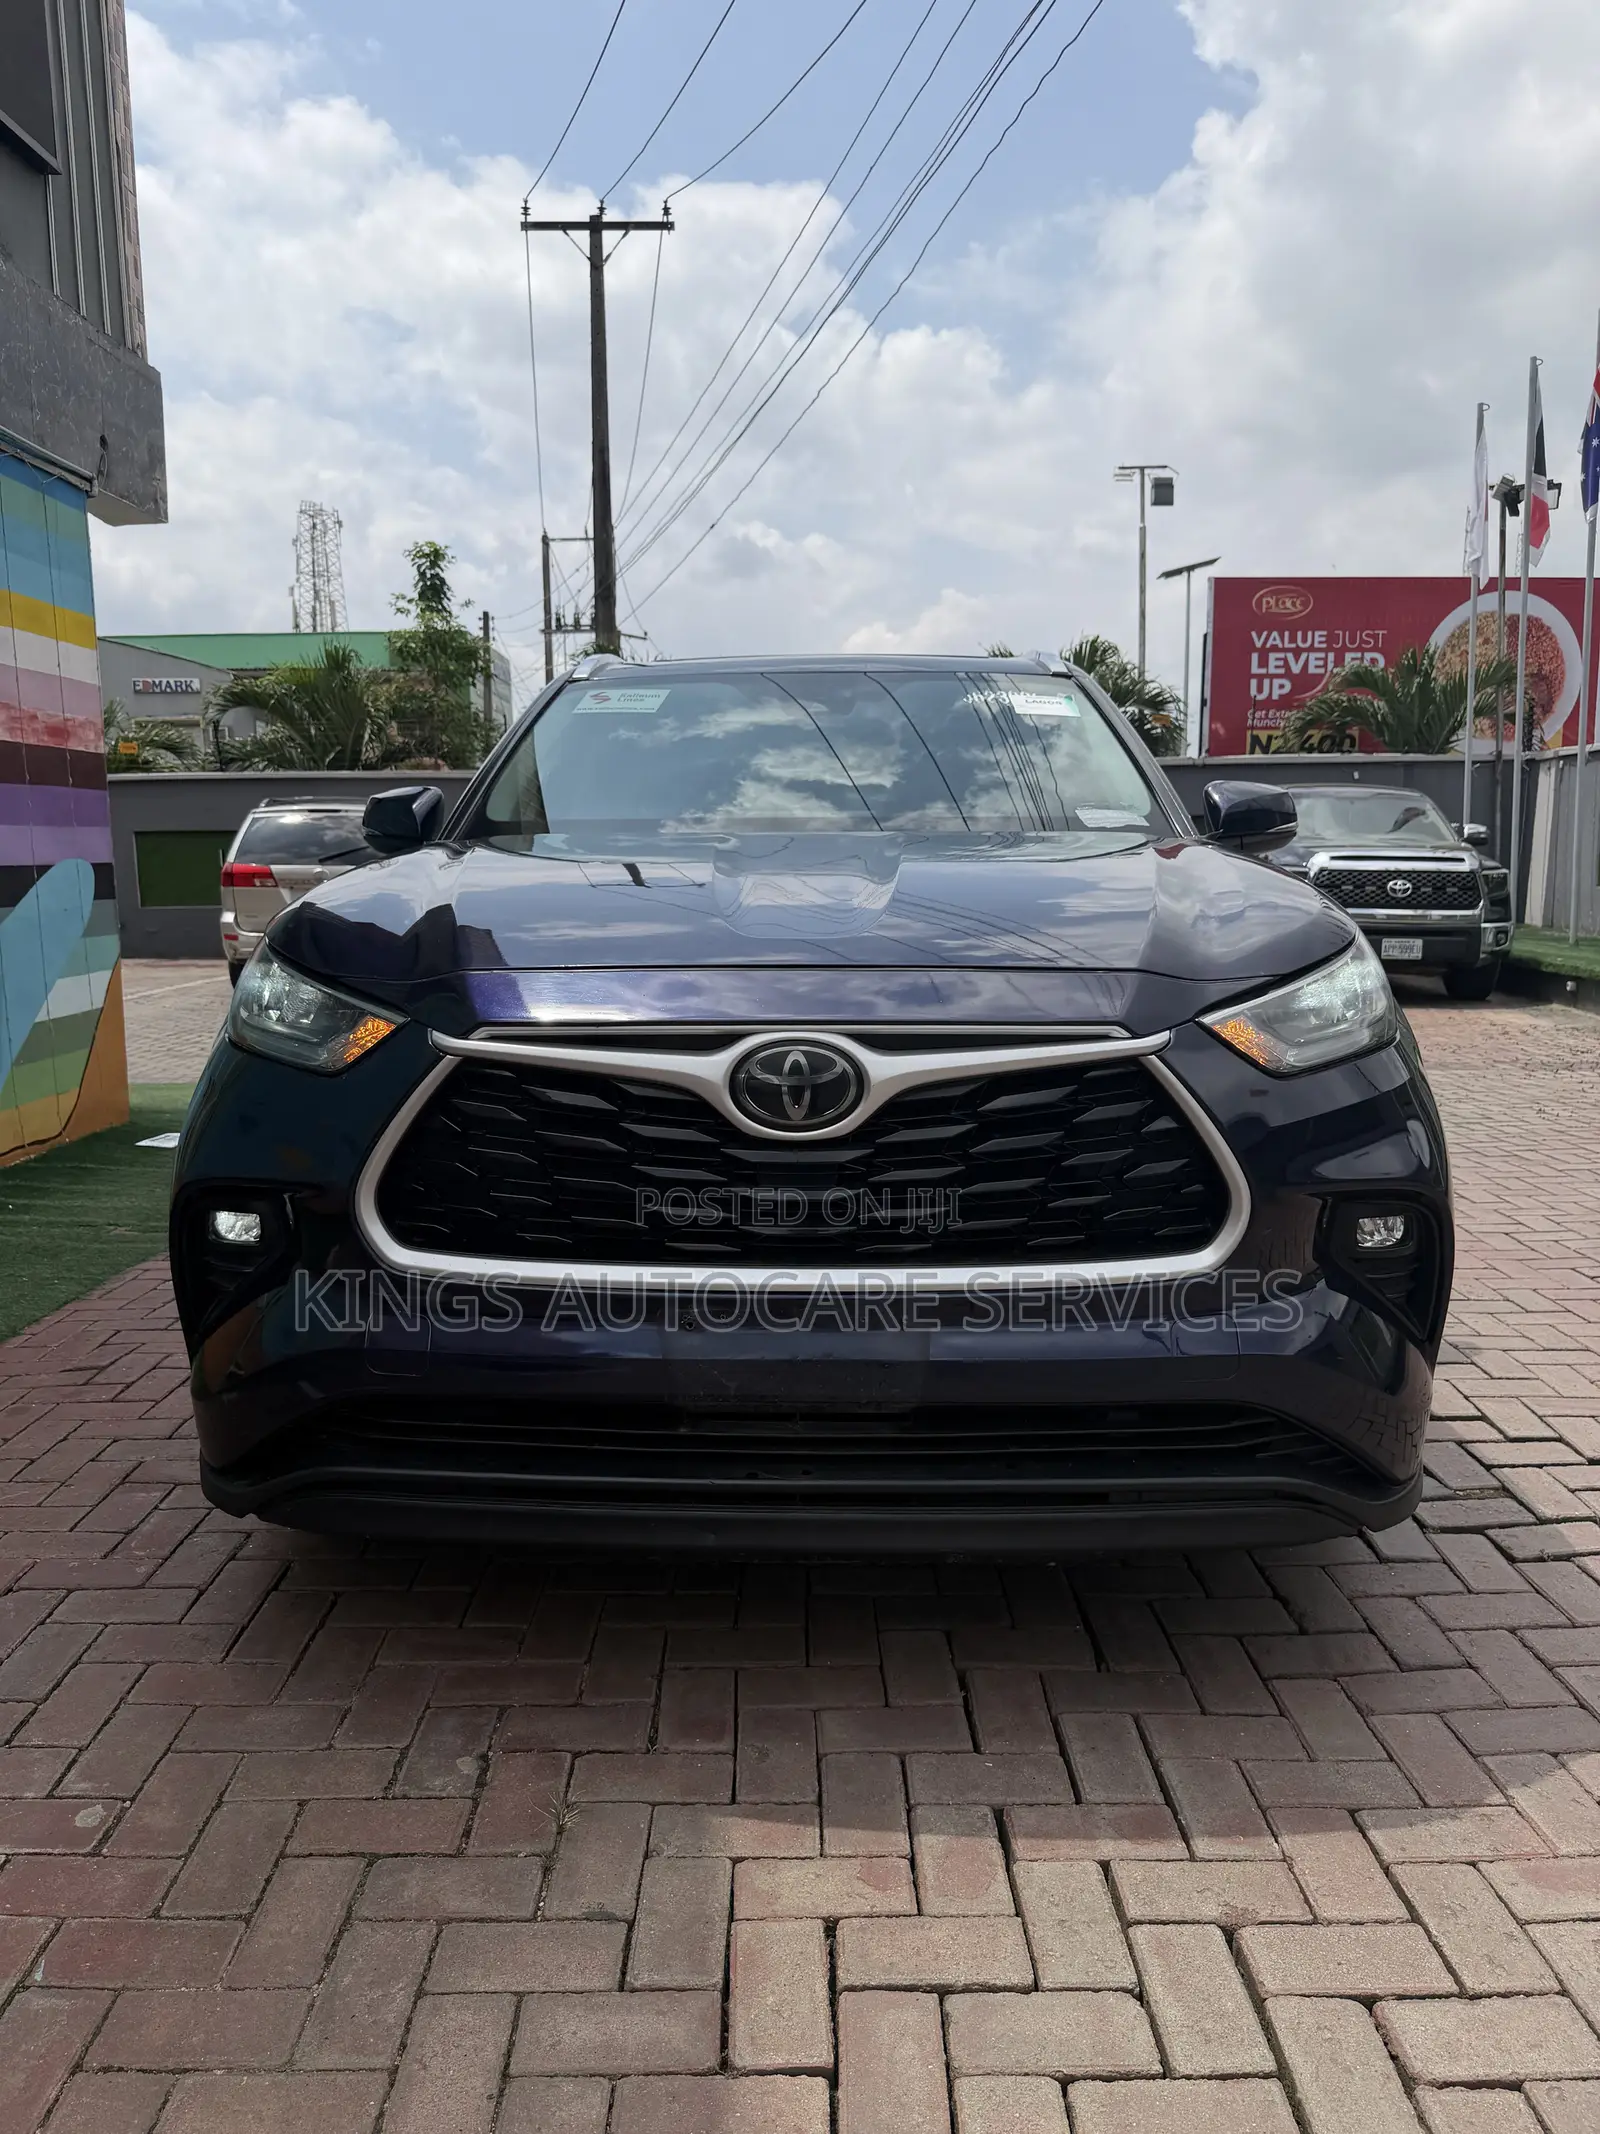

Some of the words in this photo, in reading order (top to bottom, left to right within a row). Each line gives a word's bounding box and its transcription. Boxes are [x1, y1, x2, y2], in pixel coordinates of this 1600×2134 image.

[1251, 630, 1328, 649] VALUE
[1333, 630, 1388, 649] JUST
[132, 678, 195, 693] EDMARK
[1250, 678, 1292, 701] UP
[1268, 708, 1293, 719] Extr
